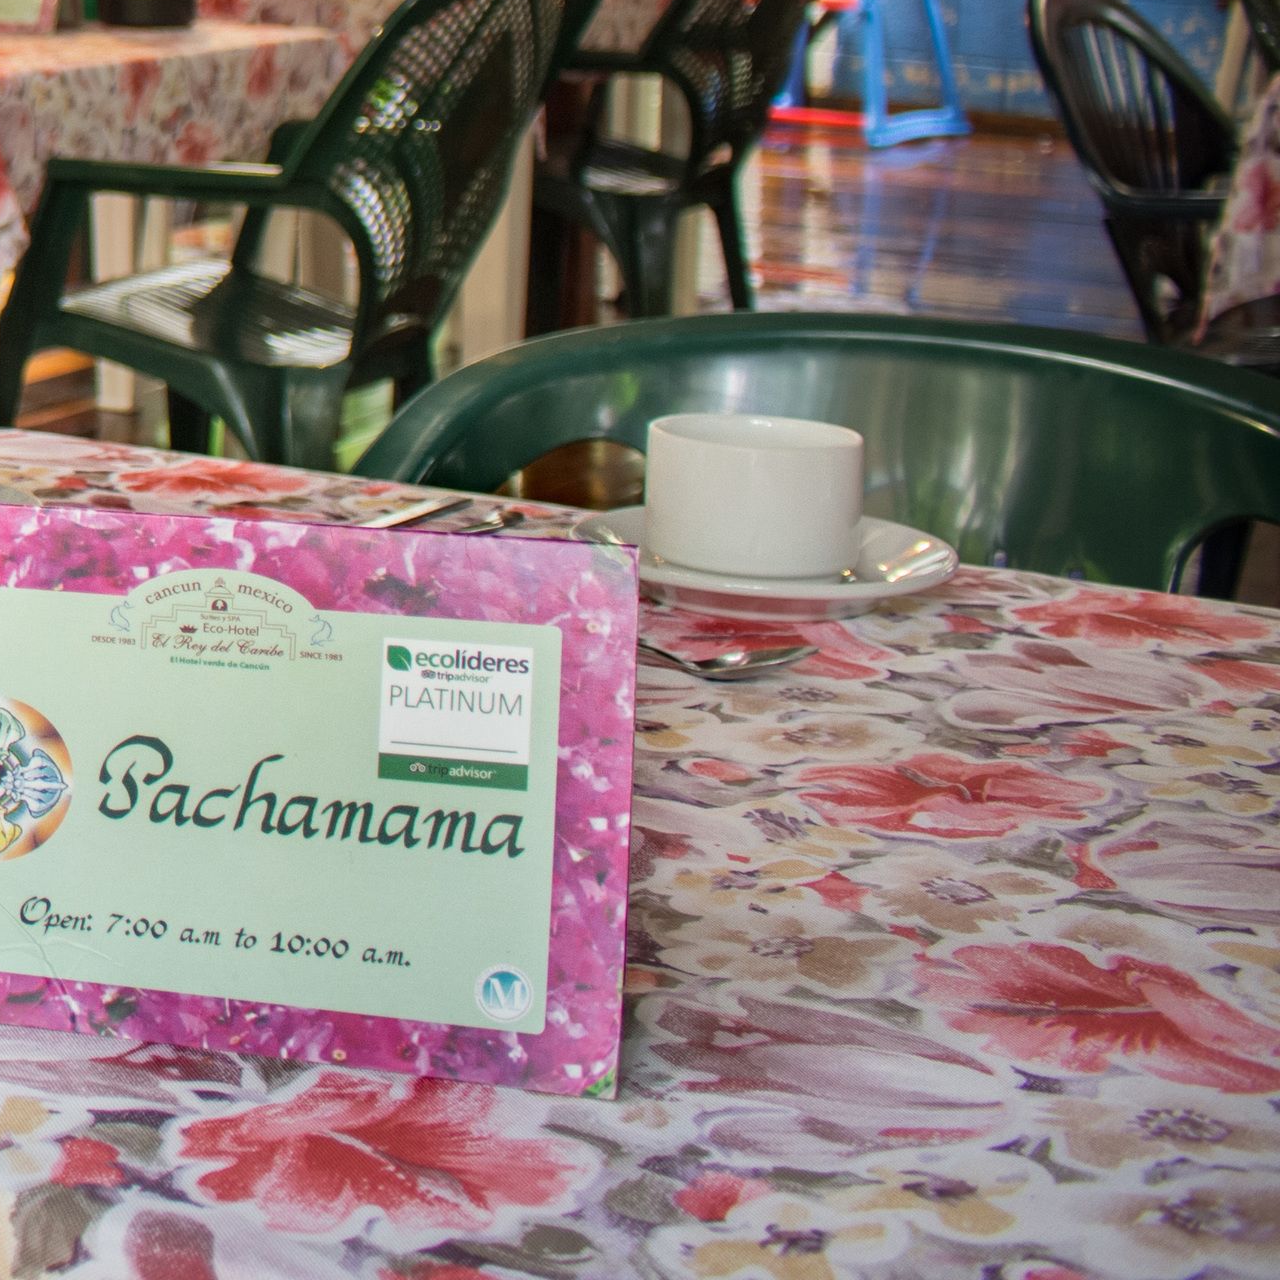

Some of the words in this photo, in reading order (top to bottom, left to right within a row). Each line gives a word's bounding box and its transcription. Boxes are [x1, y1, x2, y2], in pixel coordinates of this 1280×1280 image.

[145, 580, 202, 605] cancun
[237, 582, 293, 614] mexico
[203, 622, 260, 637] Eco-Hotel
[91, 635, 116, 645] DESDE
[118, 637, 136, 646] 1983
[152, 632, 171, 648] El
[173, 634, 207, 656] Rey
[211, 640, 235, 653] del
[236, 639, 284, 658] Caribe
[179, 656, 201, 665] Hotel
[203, 659, 225, 667] verde
[227, 660, 238, 668] de
[299, 651, 323, 660] SINCE
[415, 649, 530, 674] ecolíderes
[437, 671, 490, 683] tripadvisor
[389, 684, 523, 717] PLATINUM
[427, 763, 494, 780] tripadvisor
[97, 733, 527, 859] Pachamama
[19, 895, 93, 935] Open:
[105, 913, 168, 940] 7:00
[179, 926, 222, 947] a.m
[233, 927, 258, 949] to
[269, 931, 350, 959] 10:00
[361, 945, 412, 968] a.m.
